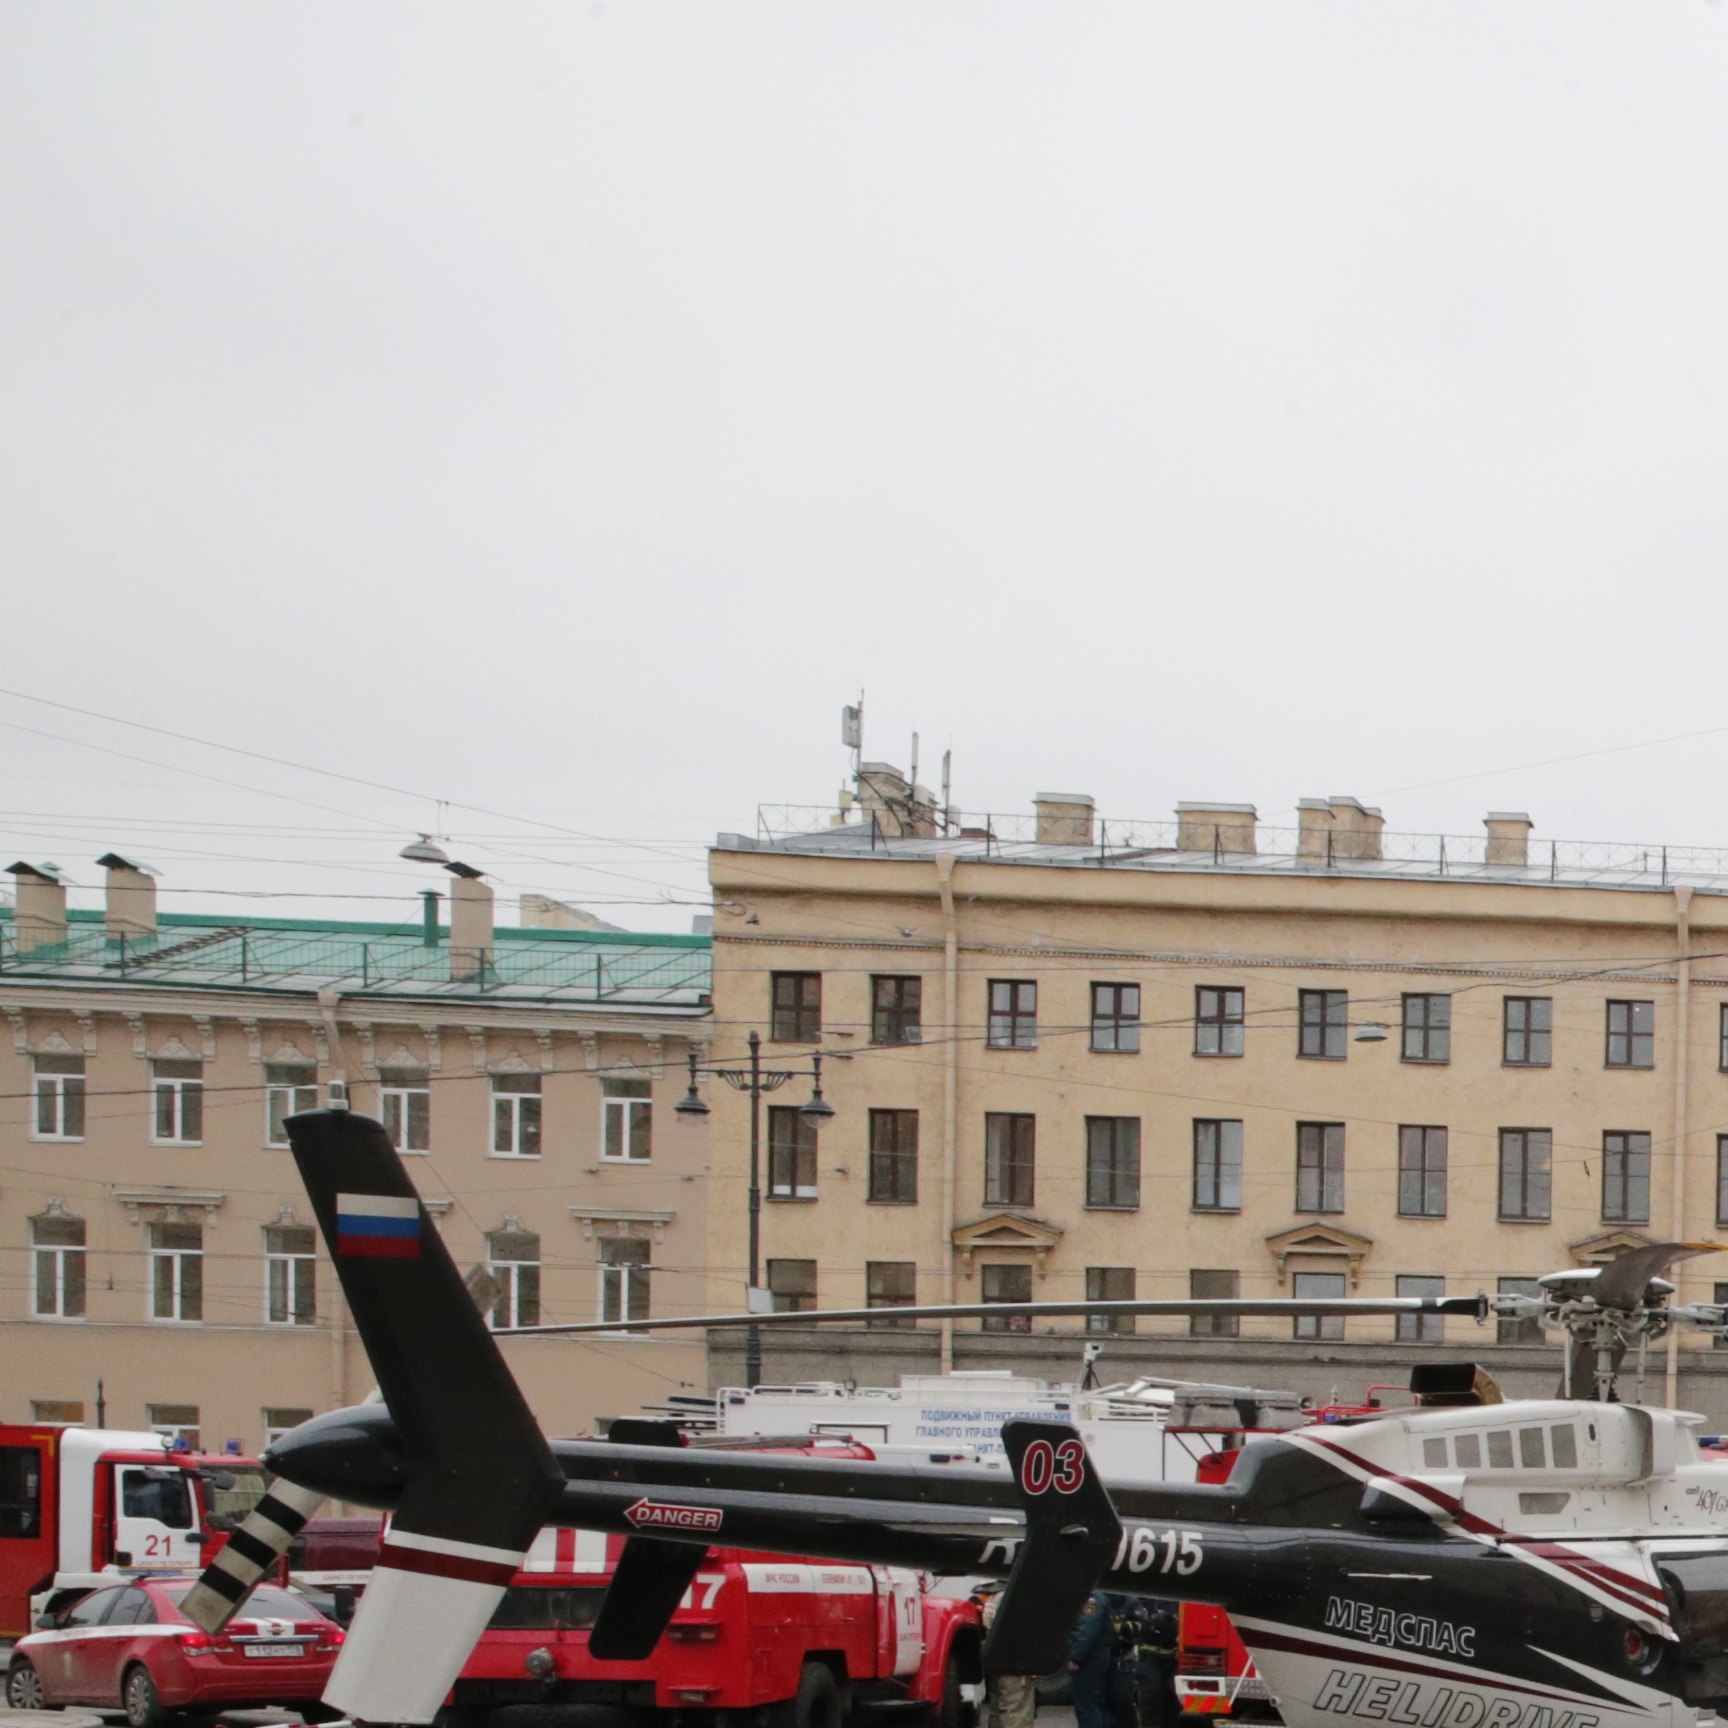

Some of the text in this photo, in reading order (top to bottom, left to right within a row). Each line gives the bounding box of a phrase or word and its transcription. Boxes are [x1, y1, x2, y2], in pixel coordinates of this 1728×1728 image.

[921, 1410, 982, 1421] ПОДВИЖНЫЙ
[984, 1411, 1012, 1421] ПУНКТ
[916, 1426, 1002, 1438] ГЛАВНОГО УПРАВЛ
[1022, 1440, 1085, 1495] 03
[636, 1507, 718, 1527] DANGER
[145, 1535, 171, 1556] 21
[1324, 1596, 1476, 1658] МЕДСПАС
